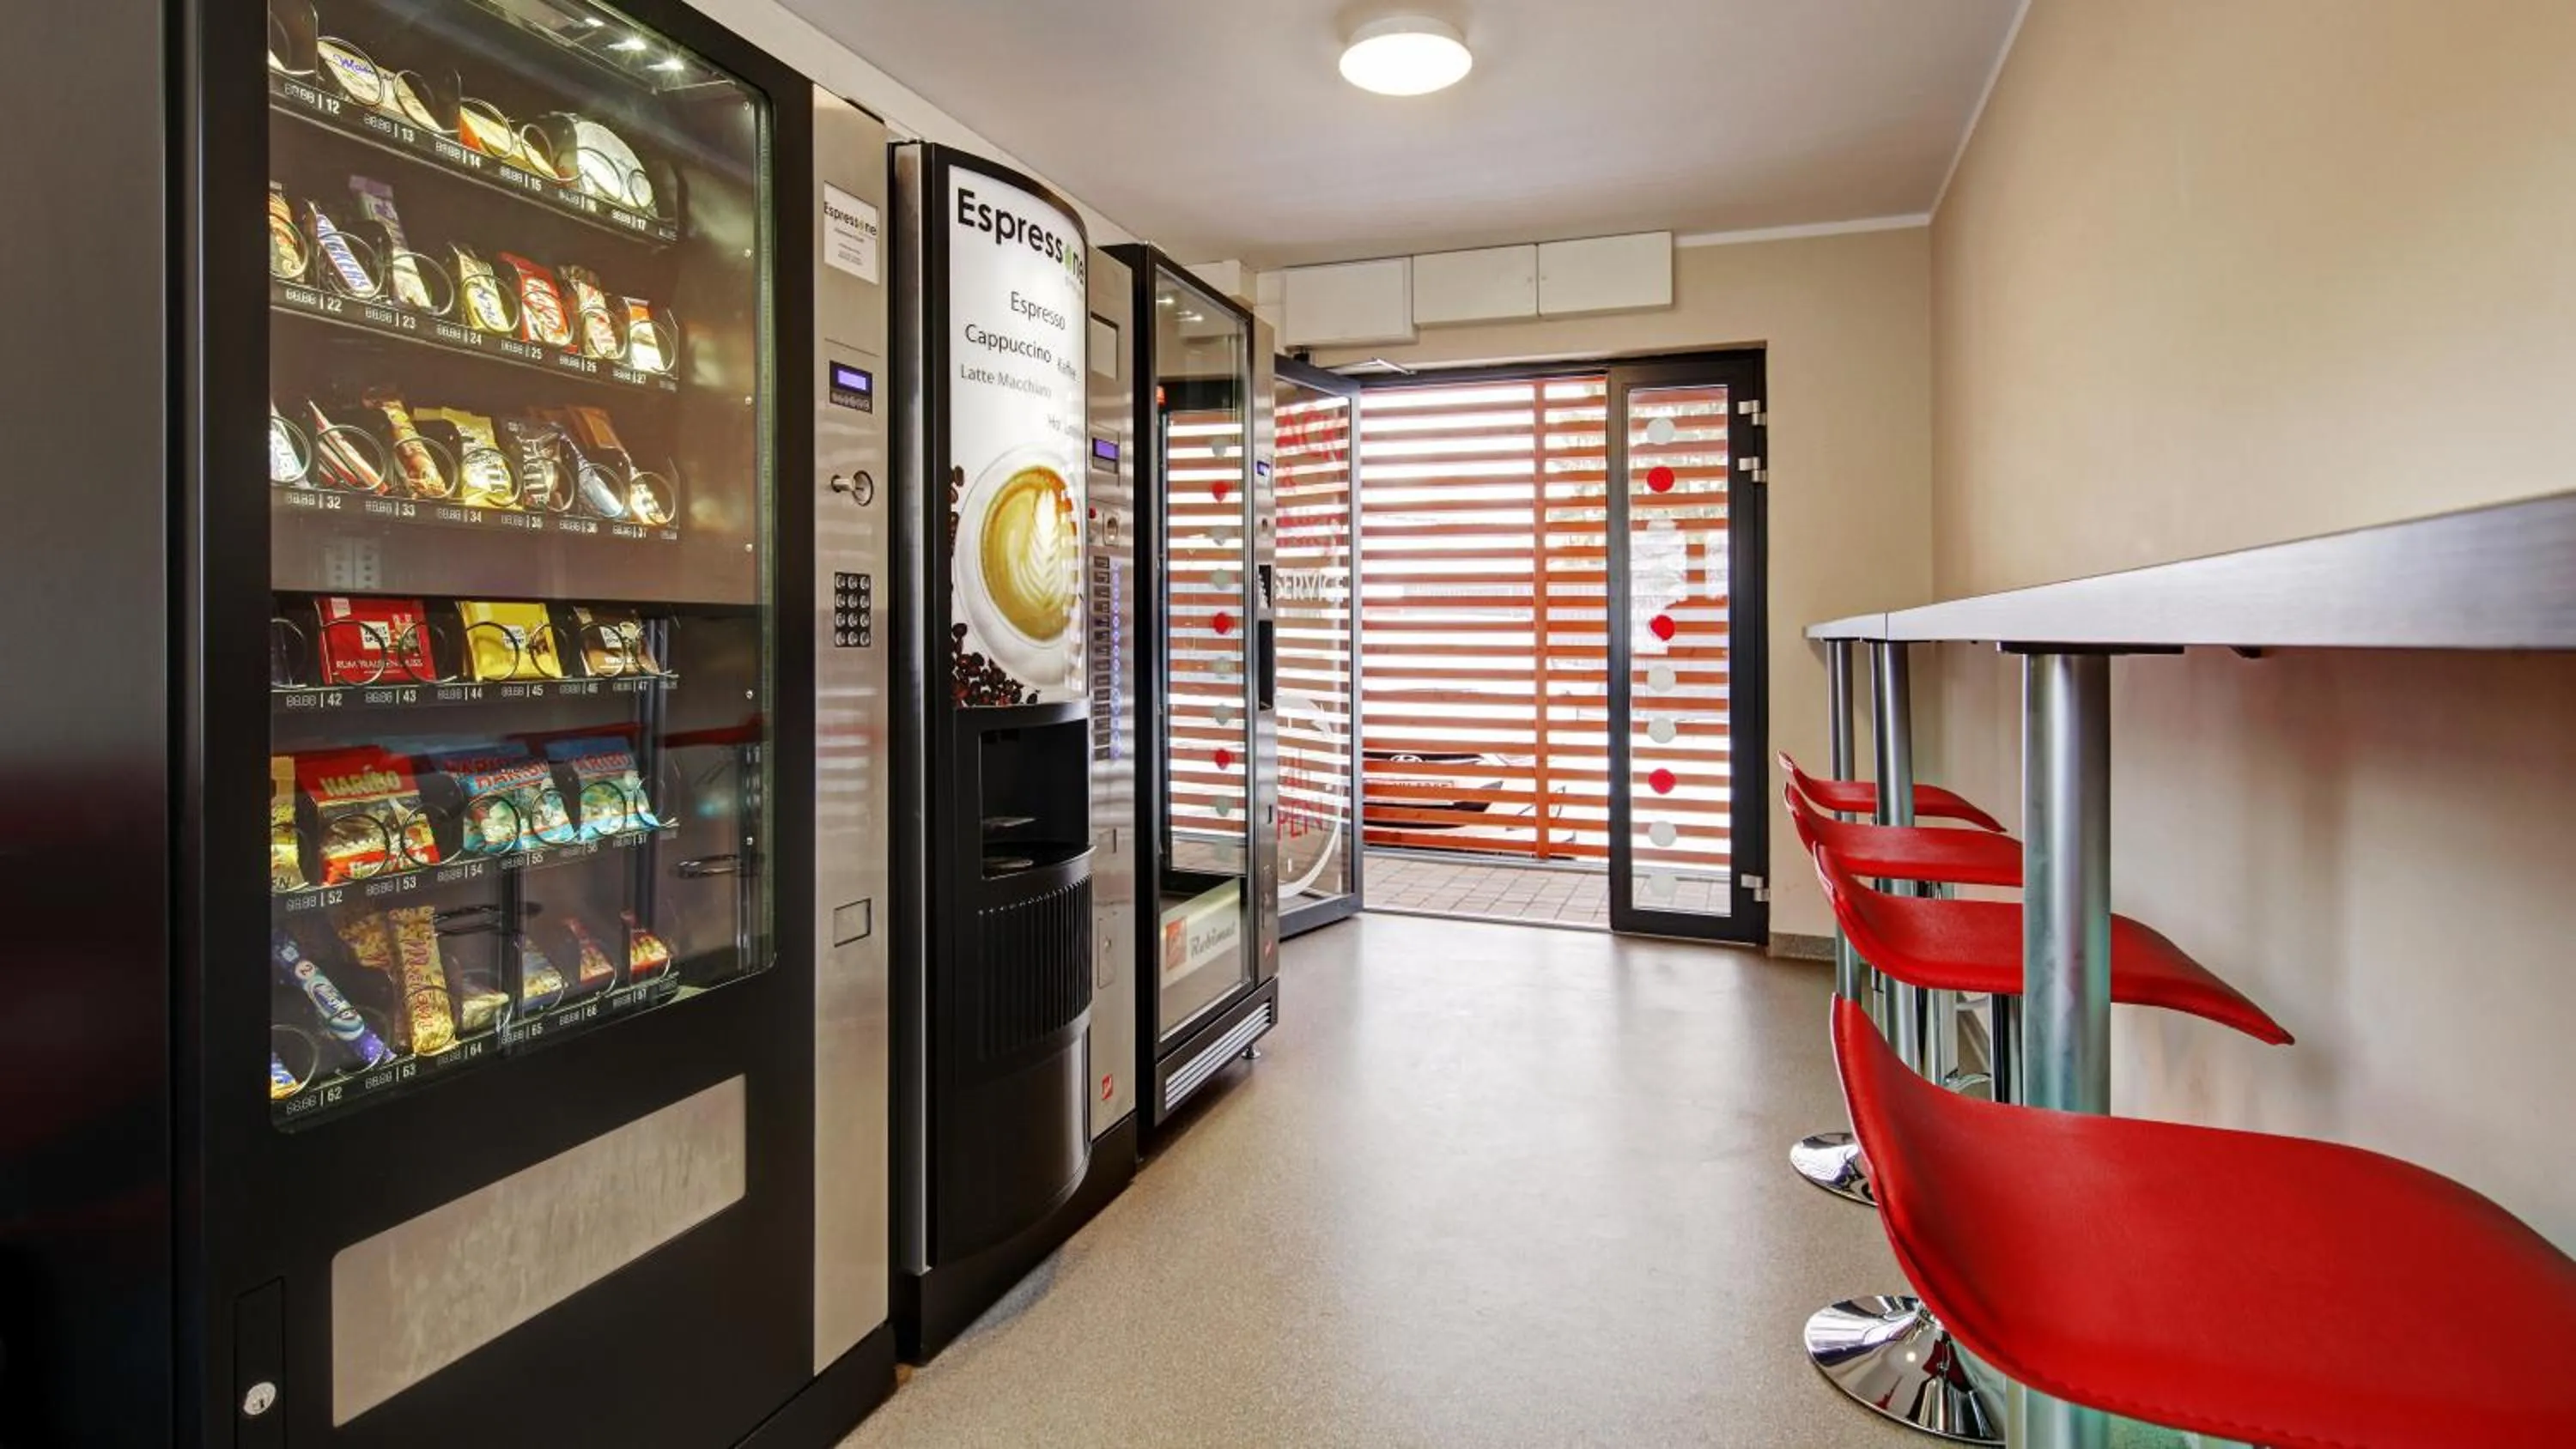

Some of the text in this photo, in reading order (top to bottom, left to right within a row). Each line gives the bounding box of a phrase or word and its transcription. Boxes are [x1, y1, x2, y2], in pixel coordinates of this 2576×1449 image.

[326, 99, 340, 114] 12
[402, 128, 415, 142] 13
[470, 154, 481, 168] 14
[531, 178, 542, 191] 15
[637, 217, 647, 231] 17
[327, 298, 342, 312] 22
[1011, 291, 1066, 330] Espresso
[403, 315, 416, 329] 23
[470, 330, 482, 345] 24
[965, 324, 1052, 363] Cappuccino
[532, 346, 542, 360] 25
[961, 363, 994, 384] Latte
[327, 496, 341, 509] 32
[402, 503, 416, 516] 33
[470, 509, 482, 523] 34
[404, 689, 416, 702] 43
[471, 687, 483, 700] 44
[532, 684, 544, 696] 45
[327, 693, 342, 706] 42
[1277, 798, 1323, 840] PEN
[532, 852, 544, 864] 55
[470, 864, 483, 877] 54
[403, 876, 416, 889] 53
[328, 891, 343, 904] 52
[532, 1022, 543, 1037] 65
[470, 1041, 482, 1056] 64
[403, 1064, 416, 1078] 63
[327, 1086, 343, 1101] 62
